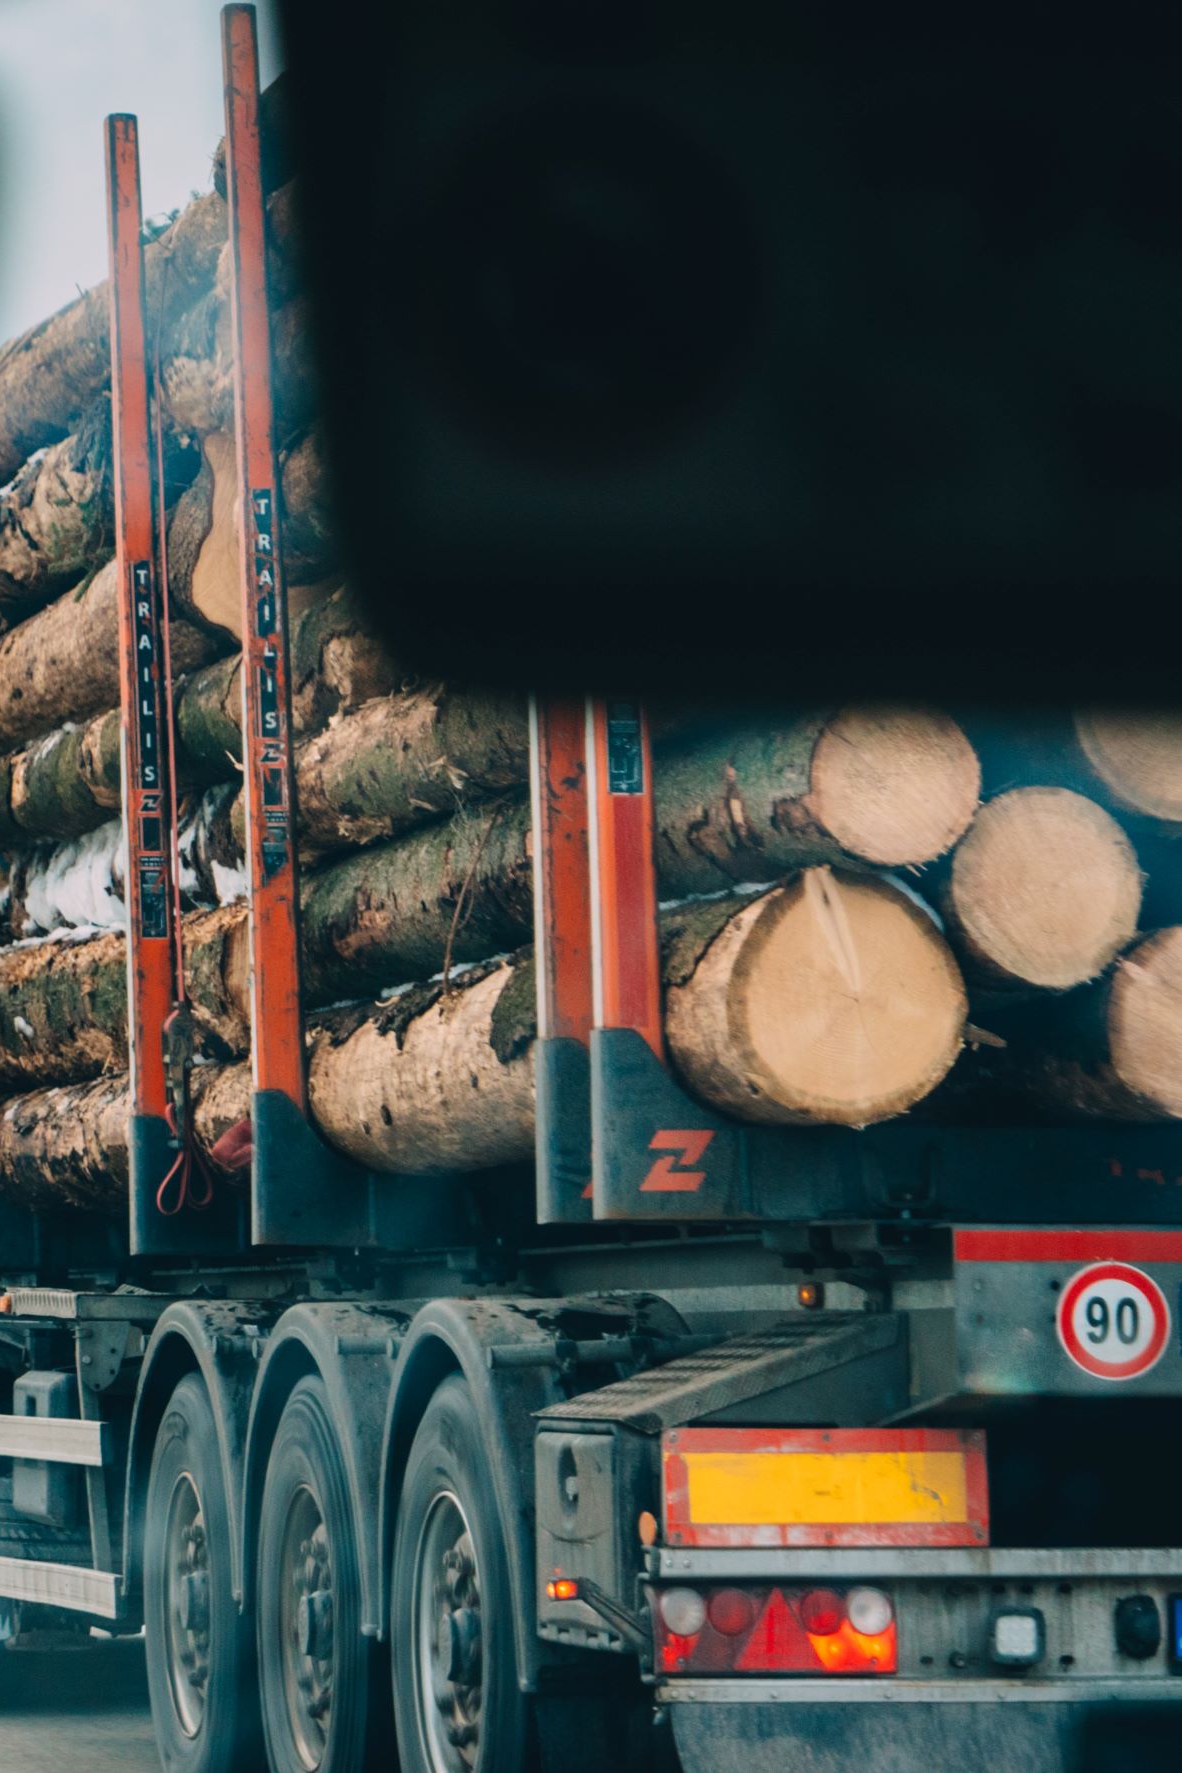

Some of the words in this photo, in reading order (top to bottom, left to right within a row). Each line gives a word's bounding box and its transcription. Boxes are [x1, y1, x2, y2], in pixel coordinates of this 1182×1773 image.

[135, 569, 156, 782] TRAILIS
[255, 498, 277, 729] TRAILIS
[1085, 1295, 1139, 1345] 90
